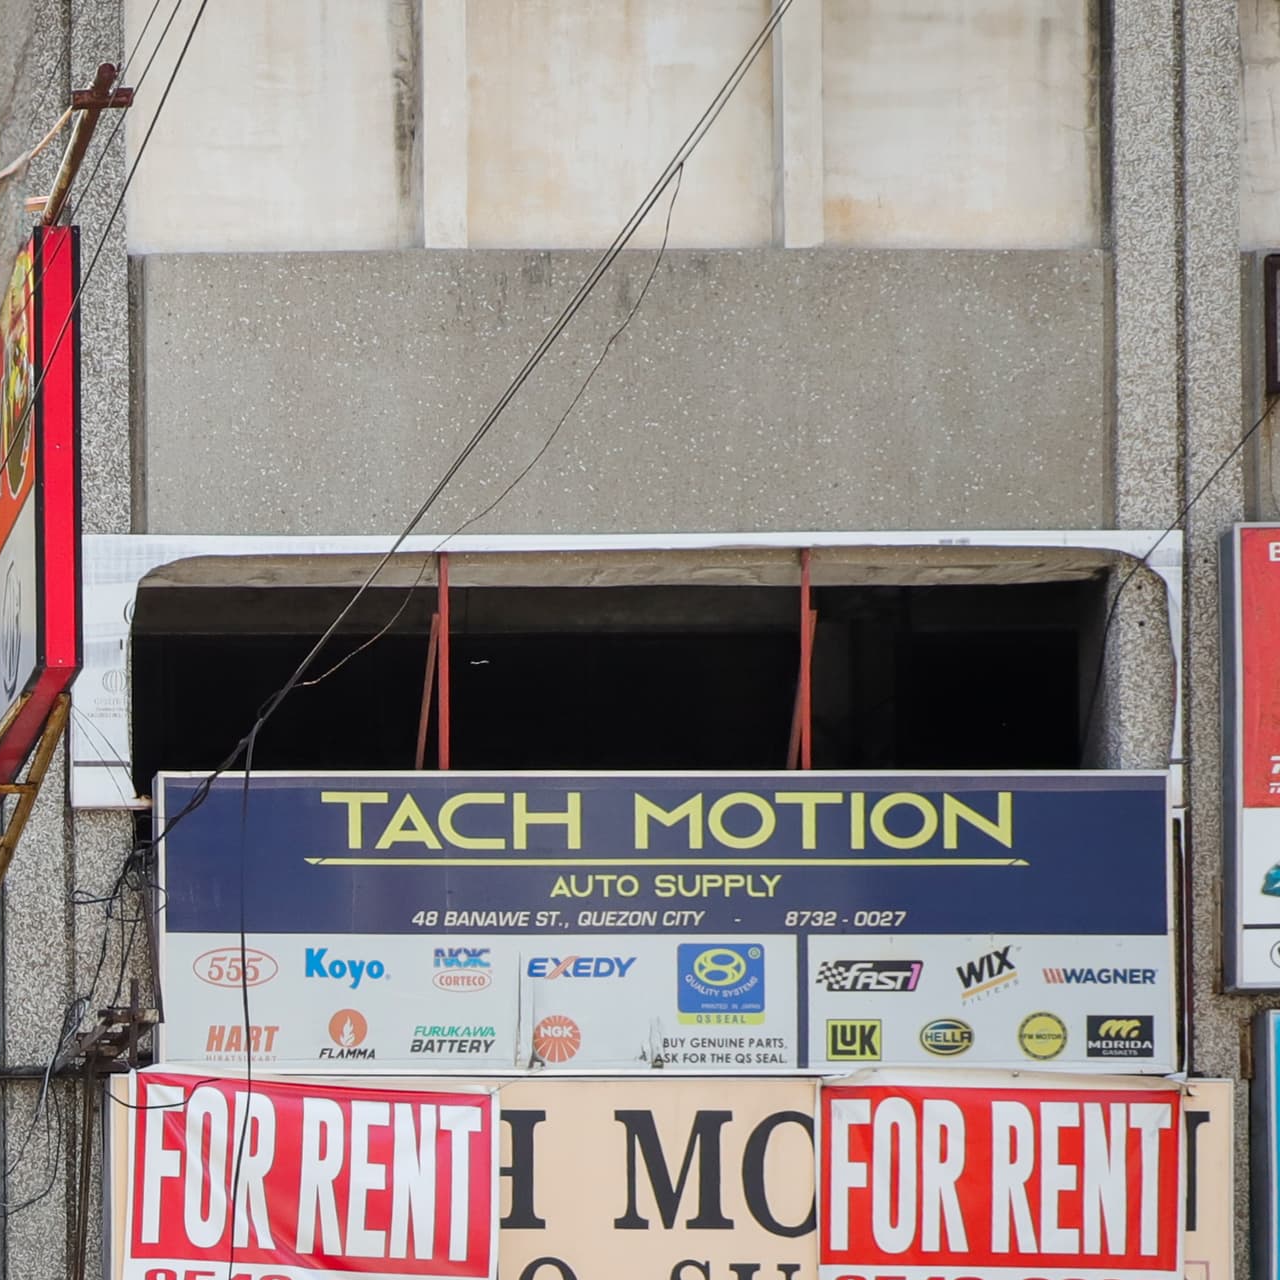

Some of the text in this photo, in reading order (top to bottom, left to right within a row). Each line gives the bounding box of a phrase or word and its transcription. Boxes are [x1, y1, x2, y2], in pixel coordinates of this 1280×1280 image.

[320, 790, 1014, 851] TACH MOTION
[549, 873, 782, 899] AUTO SUPPLY
[412, 910, 439, 928] 48
[443, 910, 530, 928] BANAWE
[577, 910, 657, 930] QUEZON
[662, 910, 706, 928] CITY
[784, 909, 837, 927] 8732
[852, 909, 907, 927] 0027
[207, 957, 260, 982] 555
[304, 947, 386, 989] Koyo
[527, 956, 638, 979] EXEDY
[956, 945, 1017, 990] WIX
[1061, 967, 1157, 985] WAGNER
[438, 974, 487, 988] CORTECO
[684, 973, 759, 999] QUALITY SYSTEMS
[715, 1014, 748, 1025] SEAL
[205, 1025, 280, 1052] HART
[414, 1024, 496, 1039] FURUKAWA
[540, 1024, 574, 1038] NGK
[924, 1030, 973, 1044] HELLA
[410, 1039, 495, 1055] BATTERY
[662, 1037, 686, 1049] BUY
[690, 1037, 744, 1049] GENUINE
[1087, 1040, 1153, 1050] MORIDA
[319, 1047, 377, 1061] FLAMMA
[683, 1053, 707, 1064] FOR
[710, 1053, 732, 1064] THE
[735, 1053, 752, 1065] QS
[756, 1053, 788, 1064] SEAL.
[142, 1074, 482, 1262] FOR RENT
[828, 1096, 972, 1257] FOR
[988, 1098, 1175, 1259] RENT
